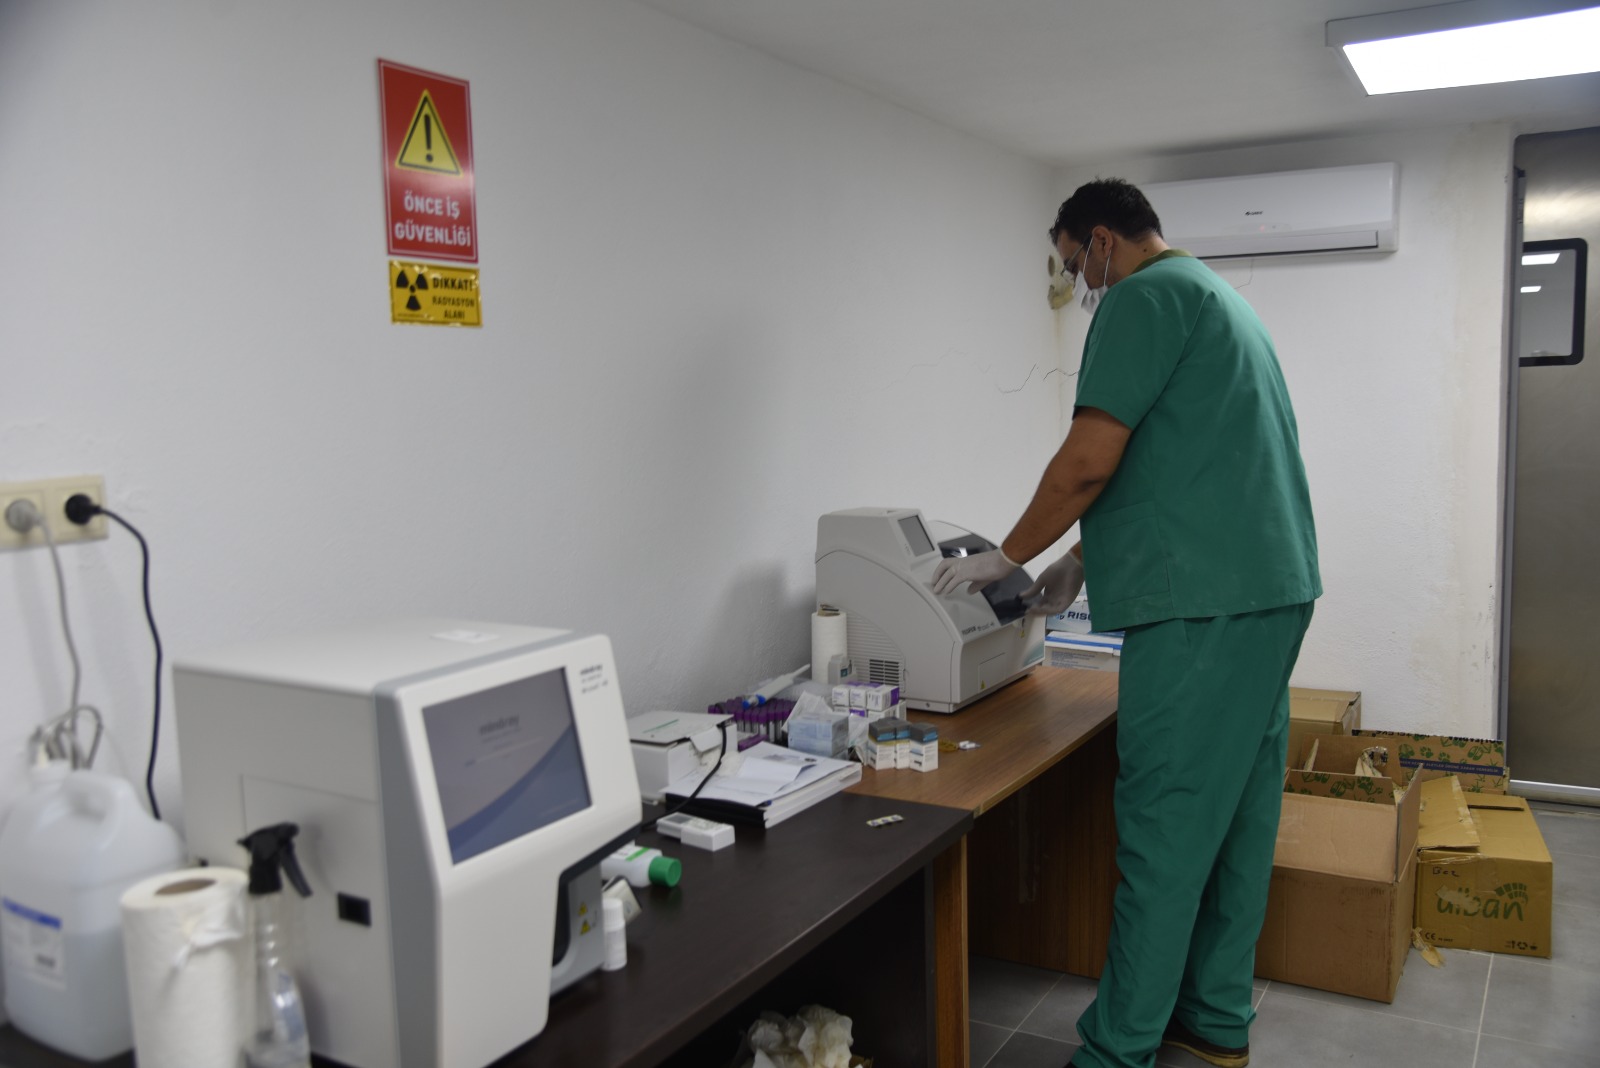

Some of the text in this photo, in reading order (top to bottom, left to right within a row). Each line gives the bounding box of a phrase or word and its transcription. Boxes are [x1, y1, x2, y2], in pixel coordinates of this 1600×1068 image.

[404, 190, 459, 219] ÖNCE İŞ
[394, 218, 472, 247] GÜVENLİĞİ
